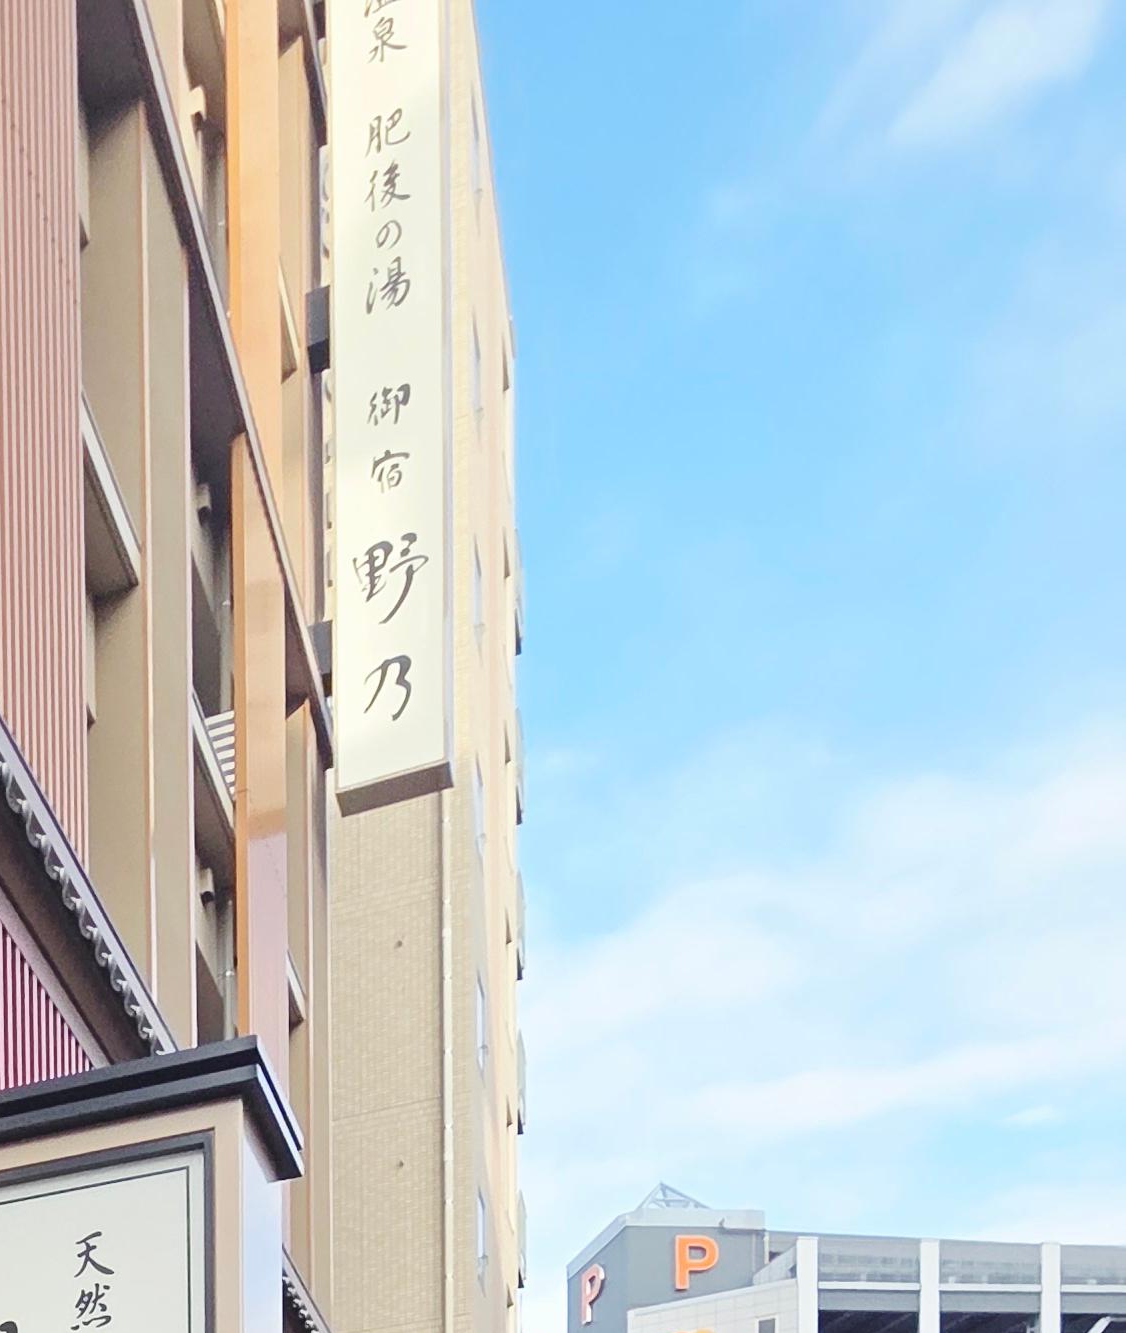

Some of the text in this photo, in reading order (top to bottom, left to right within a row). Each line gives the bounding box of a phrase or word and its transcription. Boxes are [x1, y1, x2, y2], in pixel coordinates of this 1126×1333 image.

[365, 108, 411, 315] 肥後の湯
[368, 383, 411, 489] 御宿
[352, 533, 430, 721] 野乃
[581, 1263, 606, 1326] P
[675, 1235, 719, 1290] P
